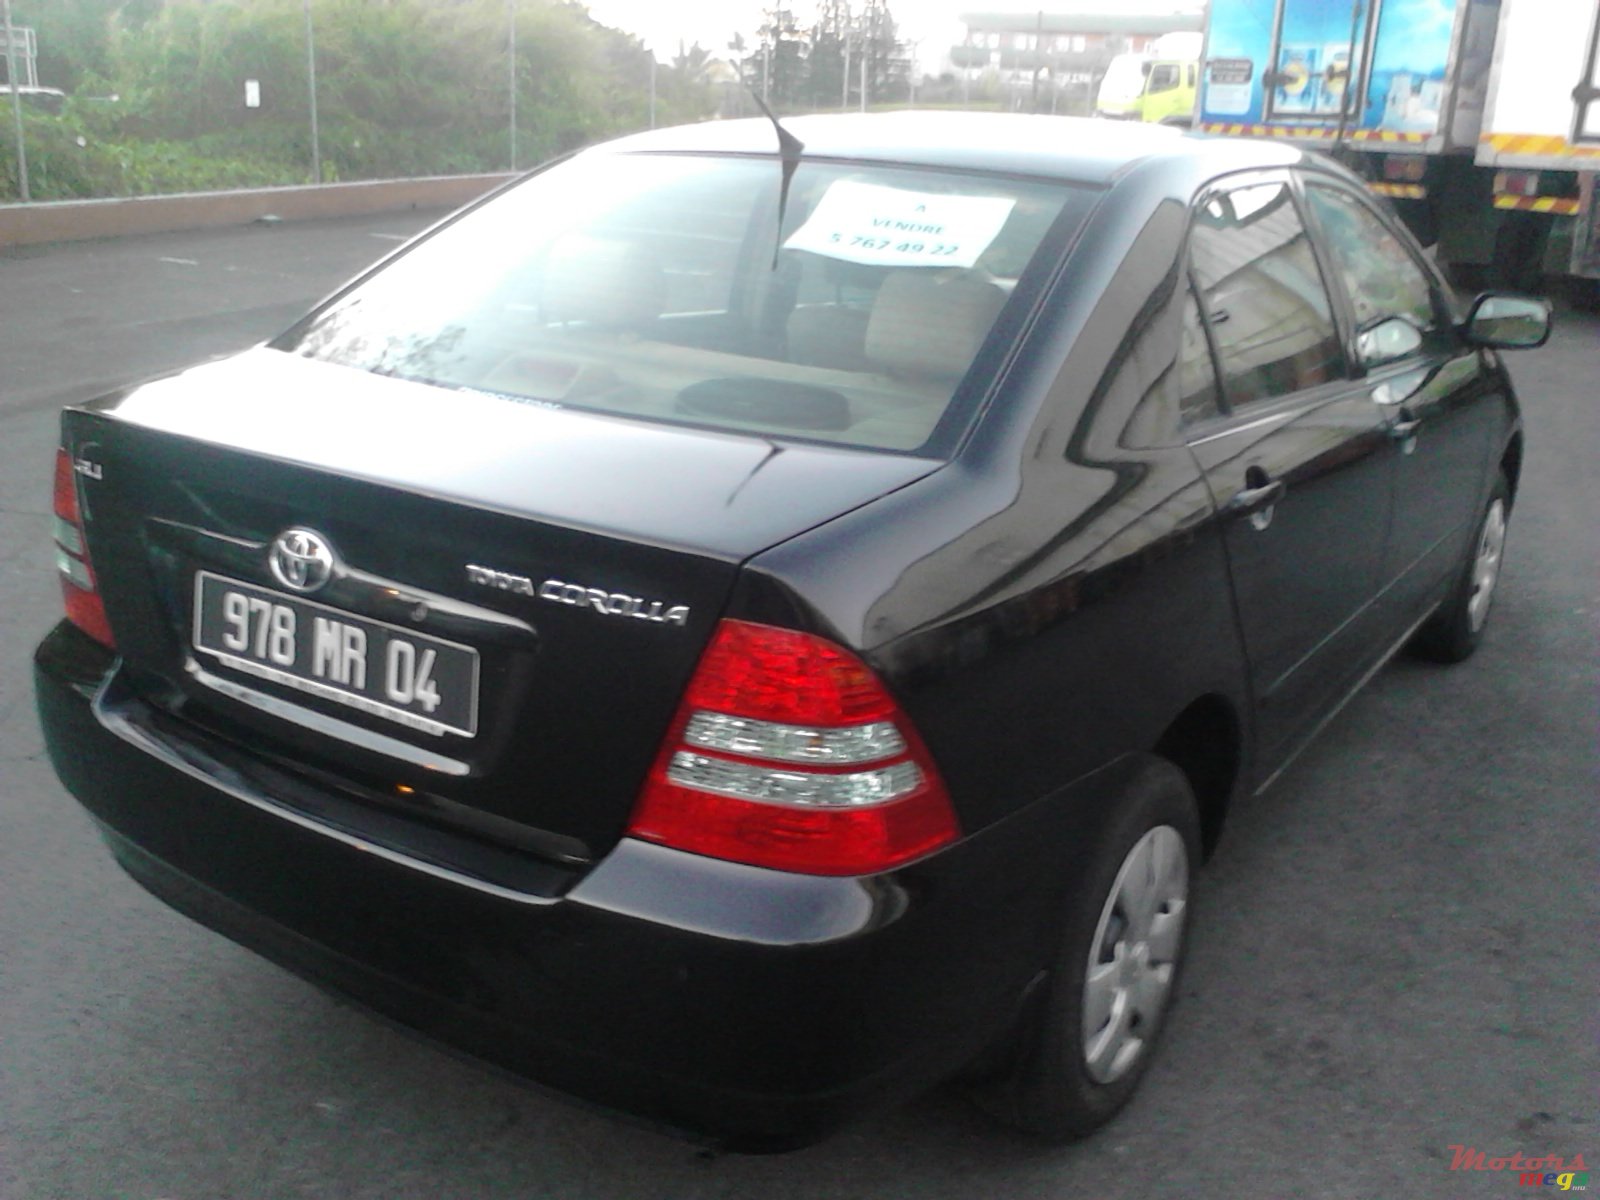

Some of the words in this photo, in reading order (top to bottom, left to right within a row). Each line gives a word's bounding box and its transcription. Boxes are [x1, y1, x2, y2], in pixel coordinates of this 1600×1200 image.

[850, 236, 890, 250] 767
[896, 242, 925, 252] 49
[930, 245, 959, 256] 22
[872, 217, 945, 235] VENDRE
[465, 563, 535, 597] TOYOTA
[539, 579, 690, 627] COROLLA
[222, 591, 296, 667] 978
[312, 616, 367, 690] MR
[385, 638, 441, 713] 04
